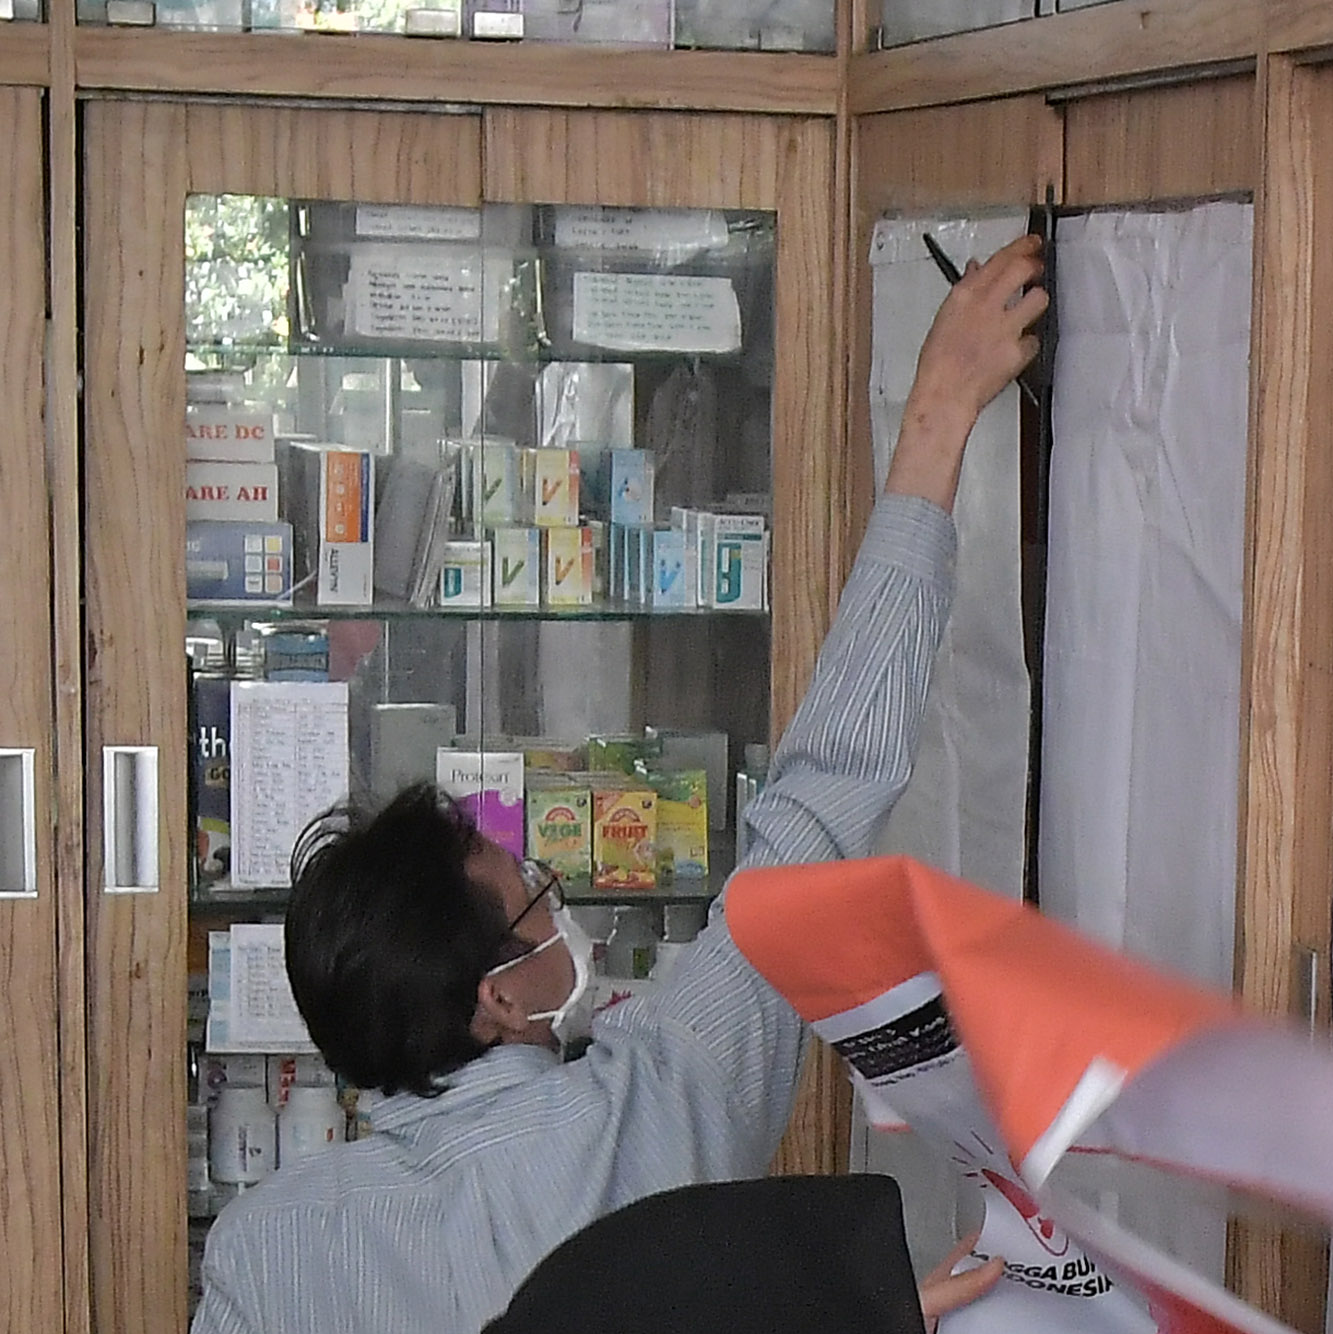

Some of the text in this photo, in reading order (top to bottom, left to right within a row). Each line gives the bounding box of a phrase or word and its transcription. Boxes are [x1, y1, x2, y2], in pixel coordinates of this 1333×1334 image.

[236, 425, 265, 439] DC
[237, 486, 268, 501] AH
[602, 825, 648, 839] FRUIT
